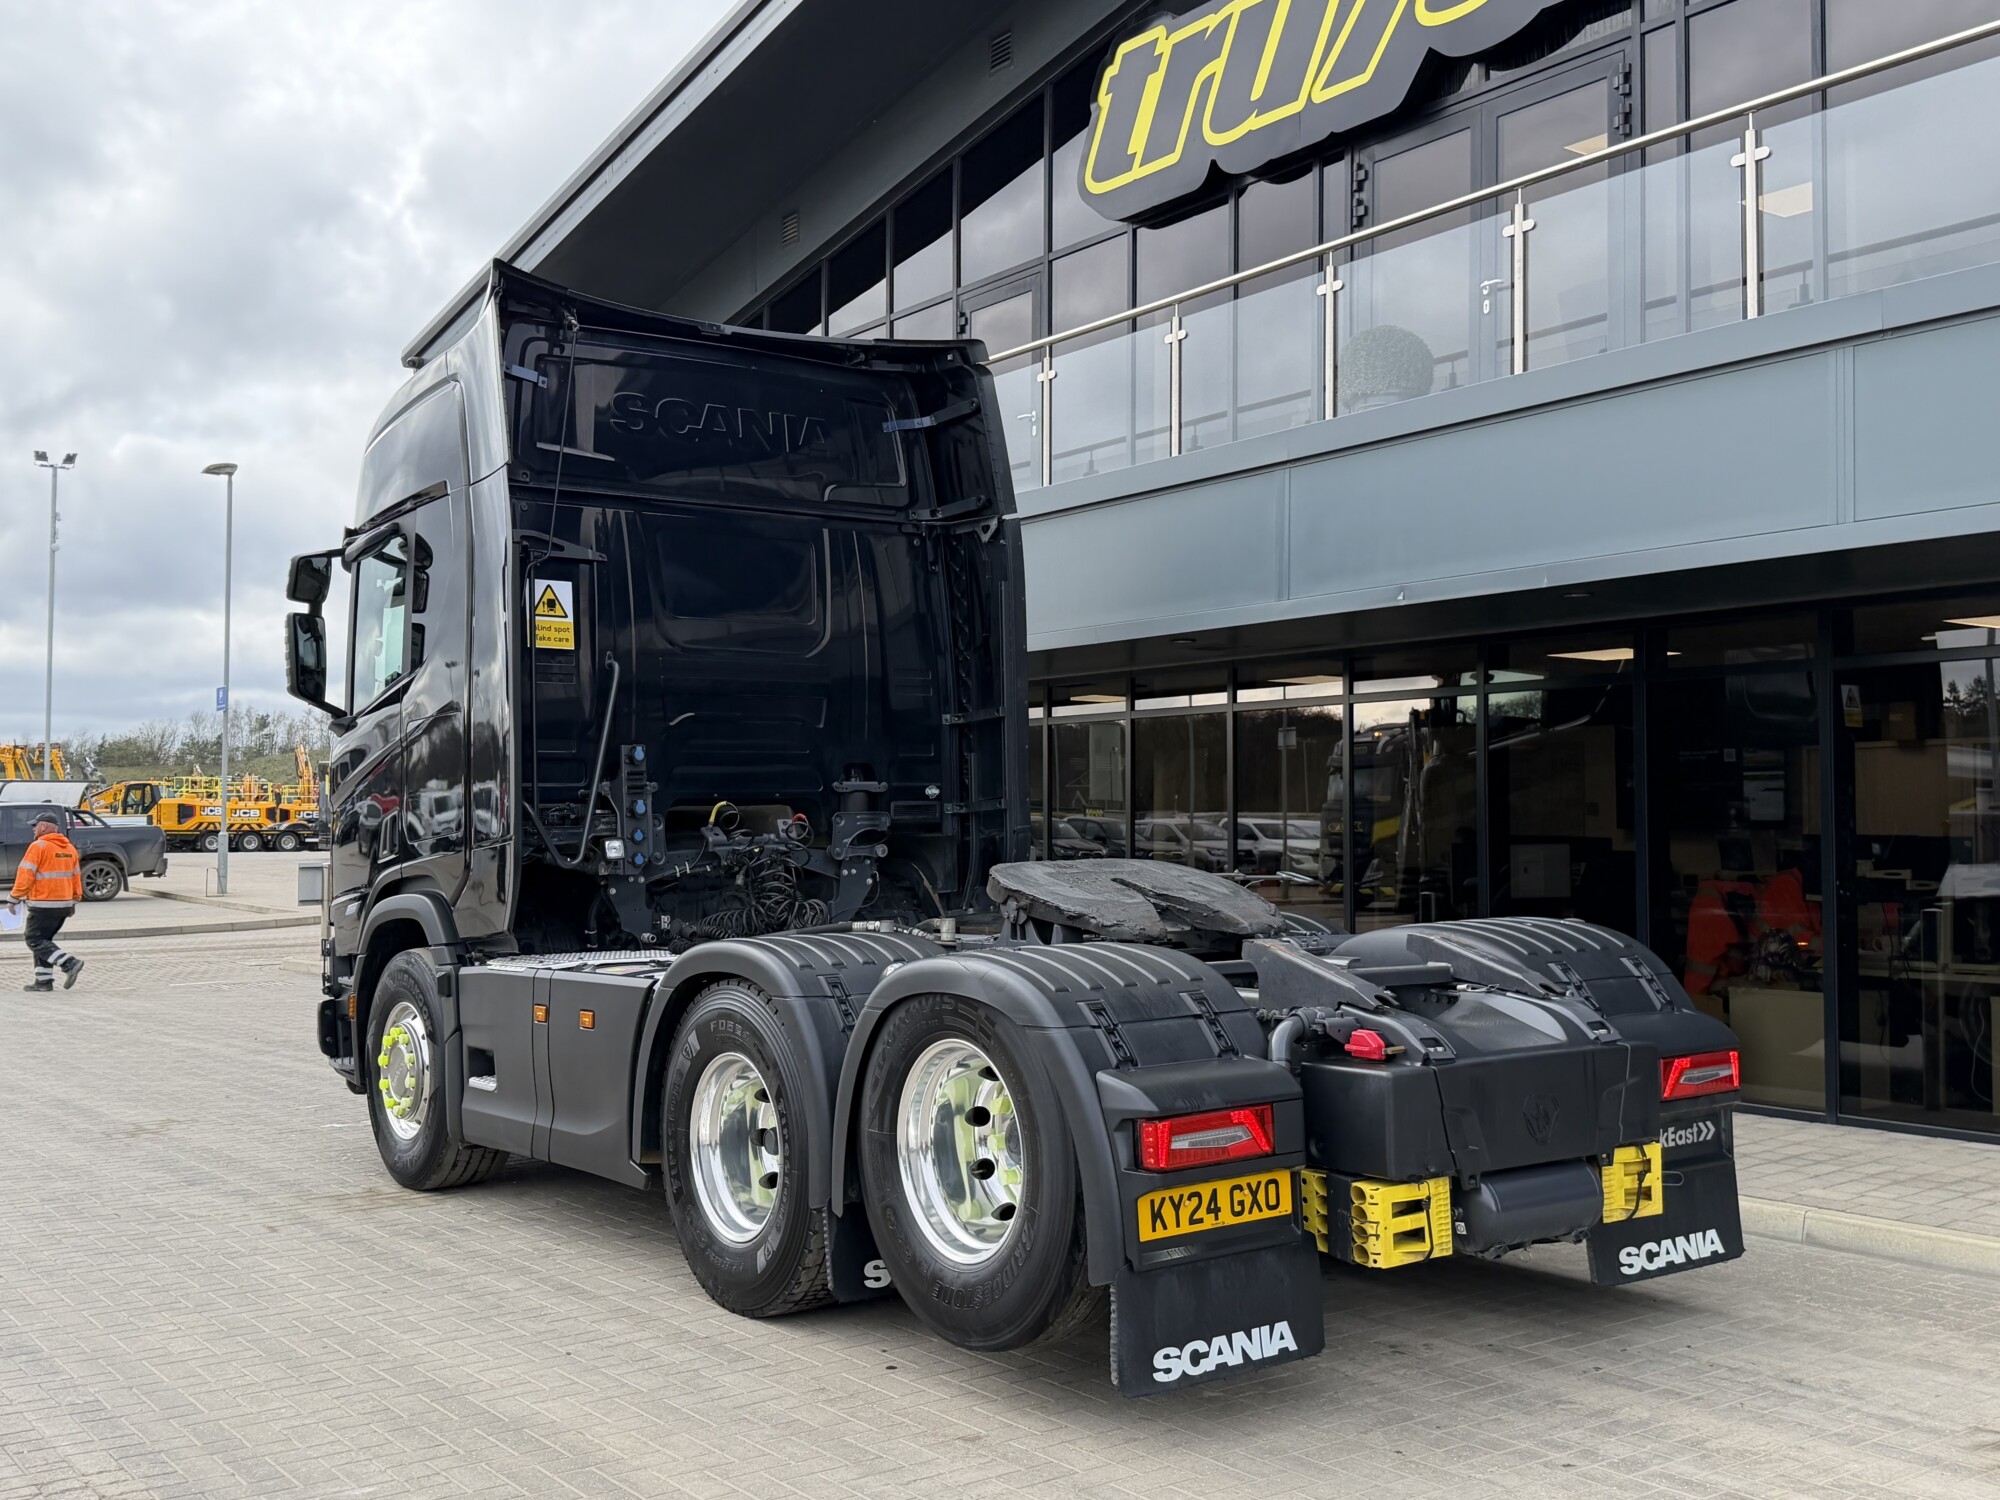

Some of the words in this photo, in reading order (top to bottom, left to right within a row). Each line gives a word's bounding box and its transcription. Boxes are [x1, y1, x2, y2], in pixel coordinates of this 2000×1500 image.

[610, 391, 834, 453] SCANIA
[535, 624, 552, 632] lind
[553, 627, 571, 635] spot
[231, 808, 261, 818] JCB
[1150, 1187, 1222, 1233] KY24
[1229, 1178, 1281, 1218] GXO
[1619, 1228, 1726, 1275] SCANIA
[1152, 1320, 1299, 1383] SCANIA
